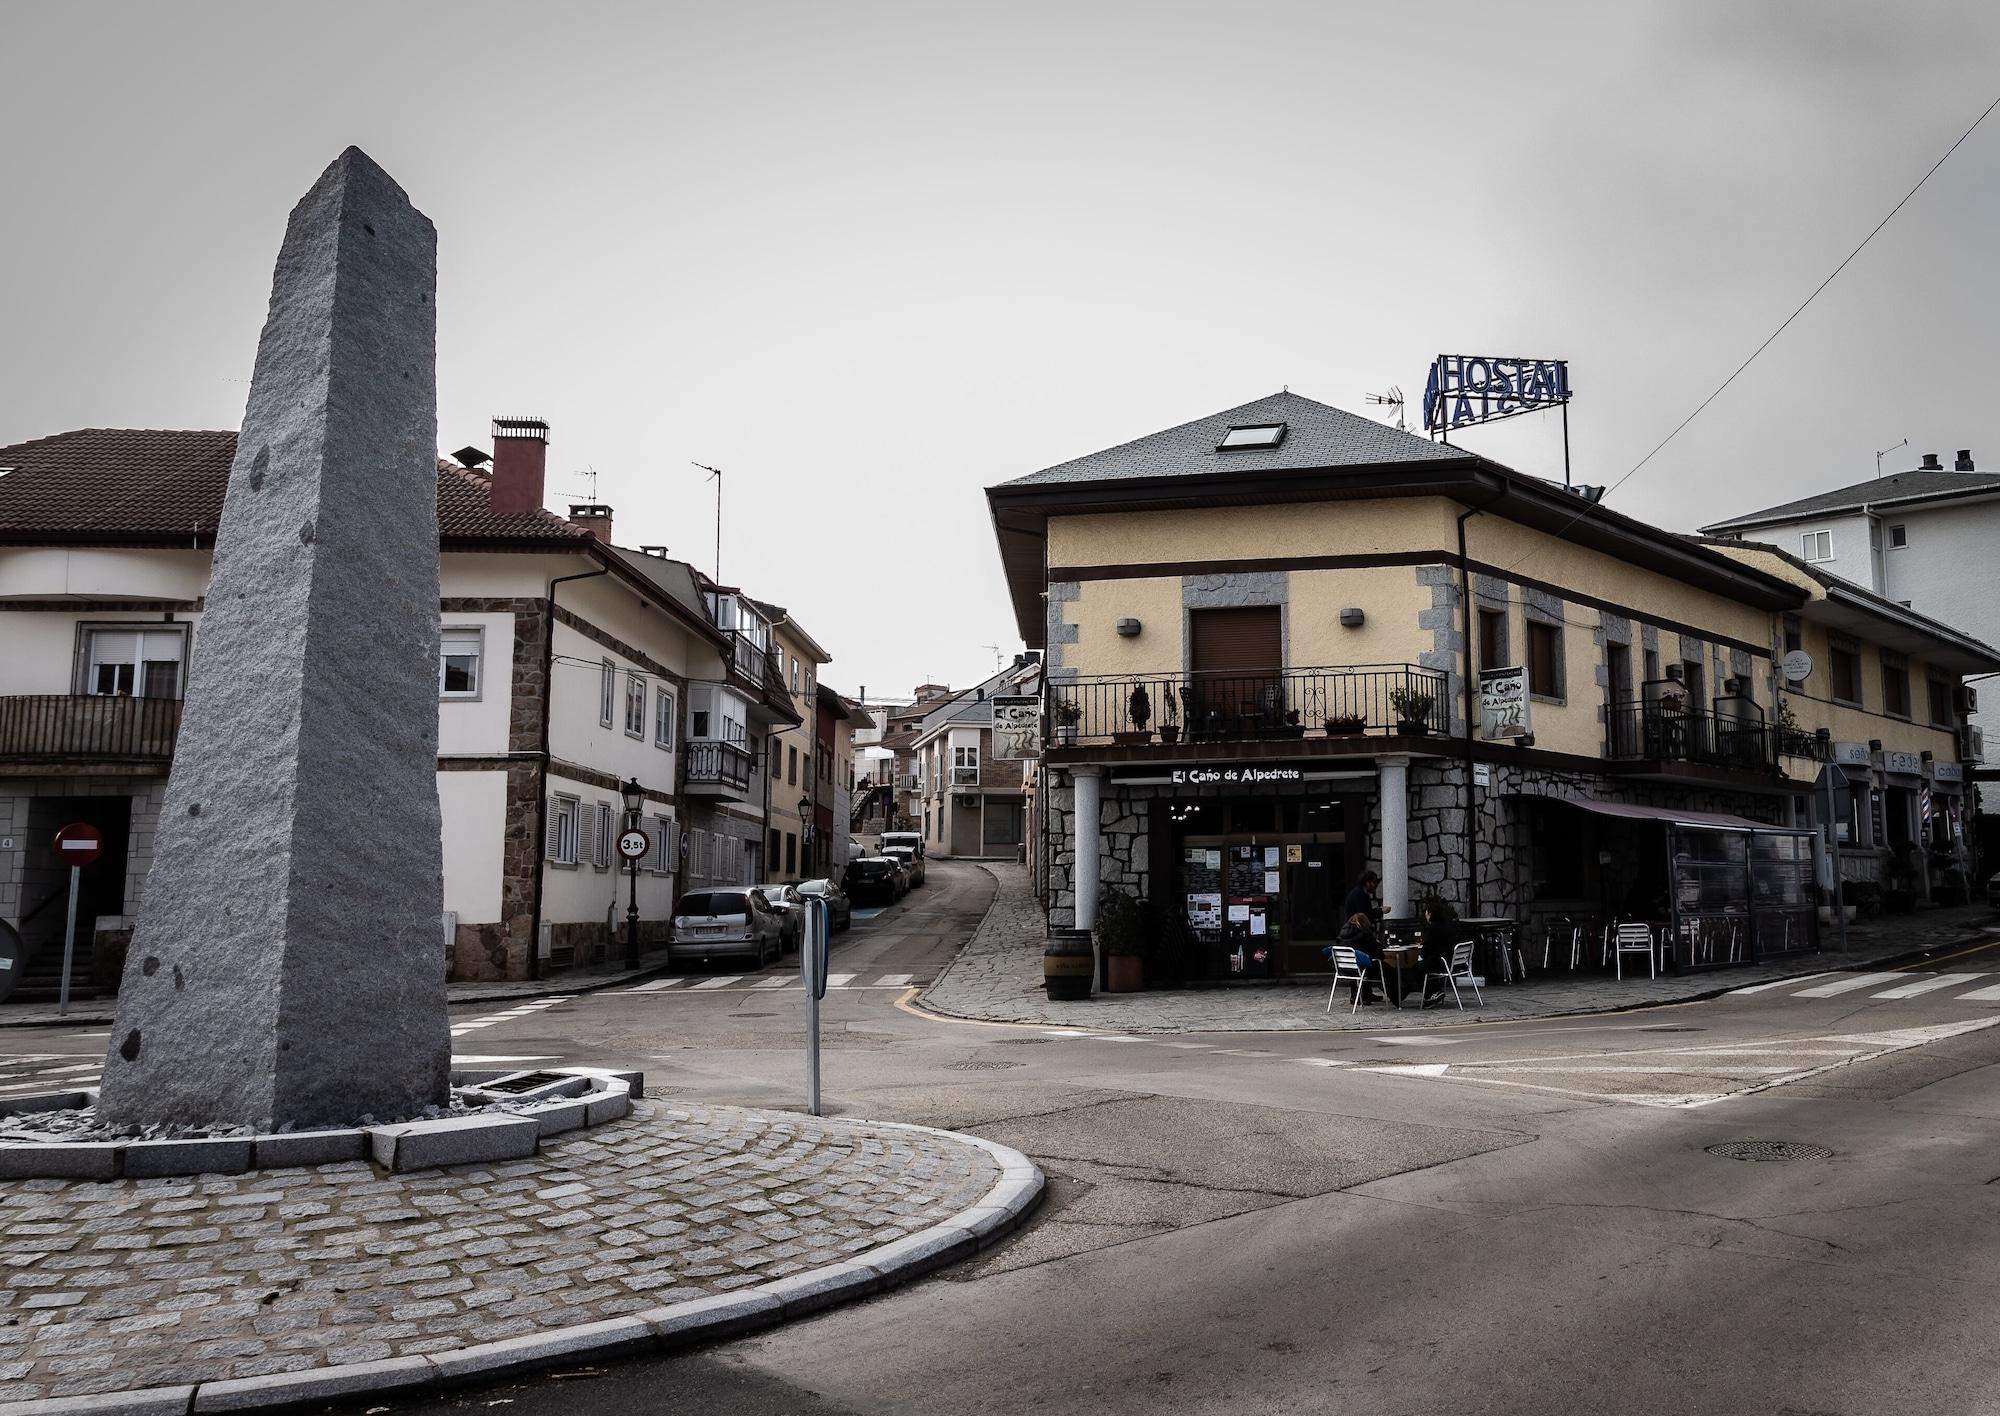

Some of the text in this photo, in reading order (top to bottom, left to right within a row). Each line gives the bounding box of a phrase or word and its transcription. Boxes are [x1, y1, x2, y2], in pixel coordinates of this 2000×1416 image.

[1441, 356, 1573, 397] HOSTAL
[1481, 680, 1522, 695] El Caño
[1482, 698, 1490, 706] de
[995, 707, 1037, 719] El Caño
[1172, 768, 1300, 784] El Caño de Alpedrete
